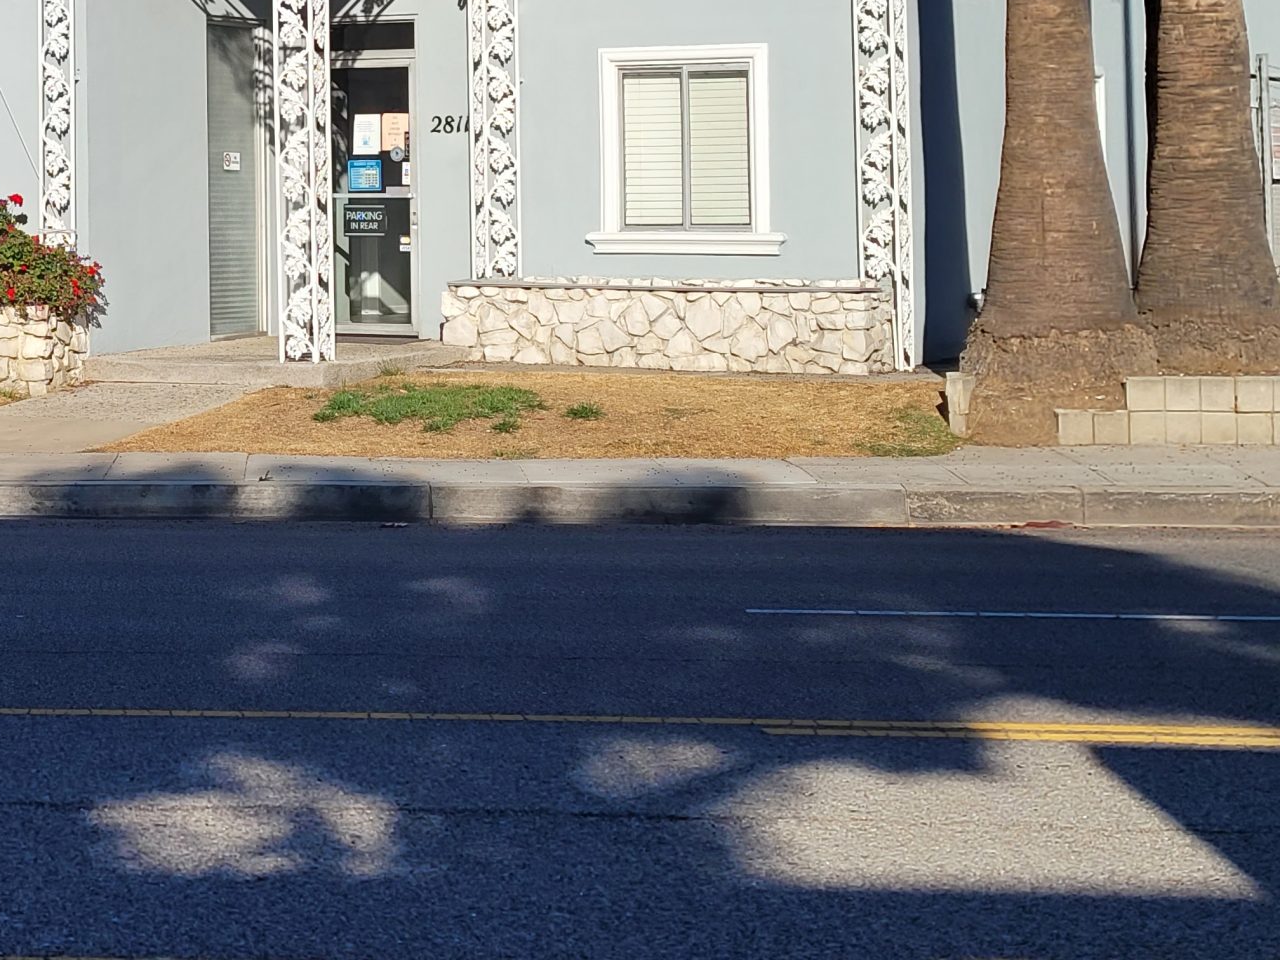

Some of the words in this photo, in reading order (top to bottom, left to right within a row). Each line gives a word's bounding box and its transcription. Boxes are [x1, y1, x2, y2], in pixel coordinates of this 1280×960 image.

[346, 211, 383, 221] PARKING
[350, 221, 359, 230] IN
[360, 221, 378, 230] REAR
